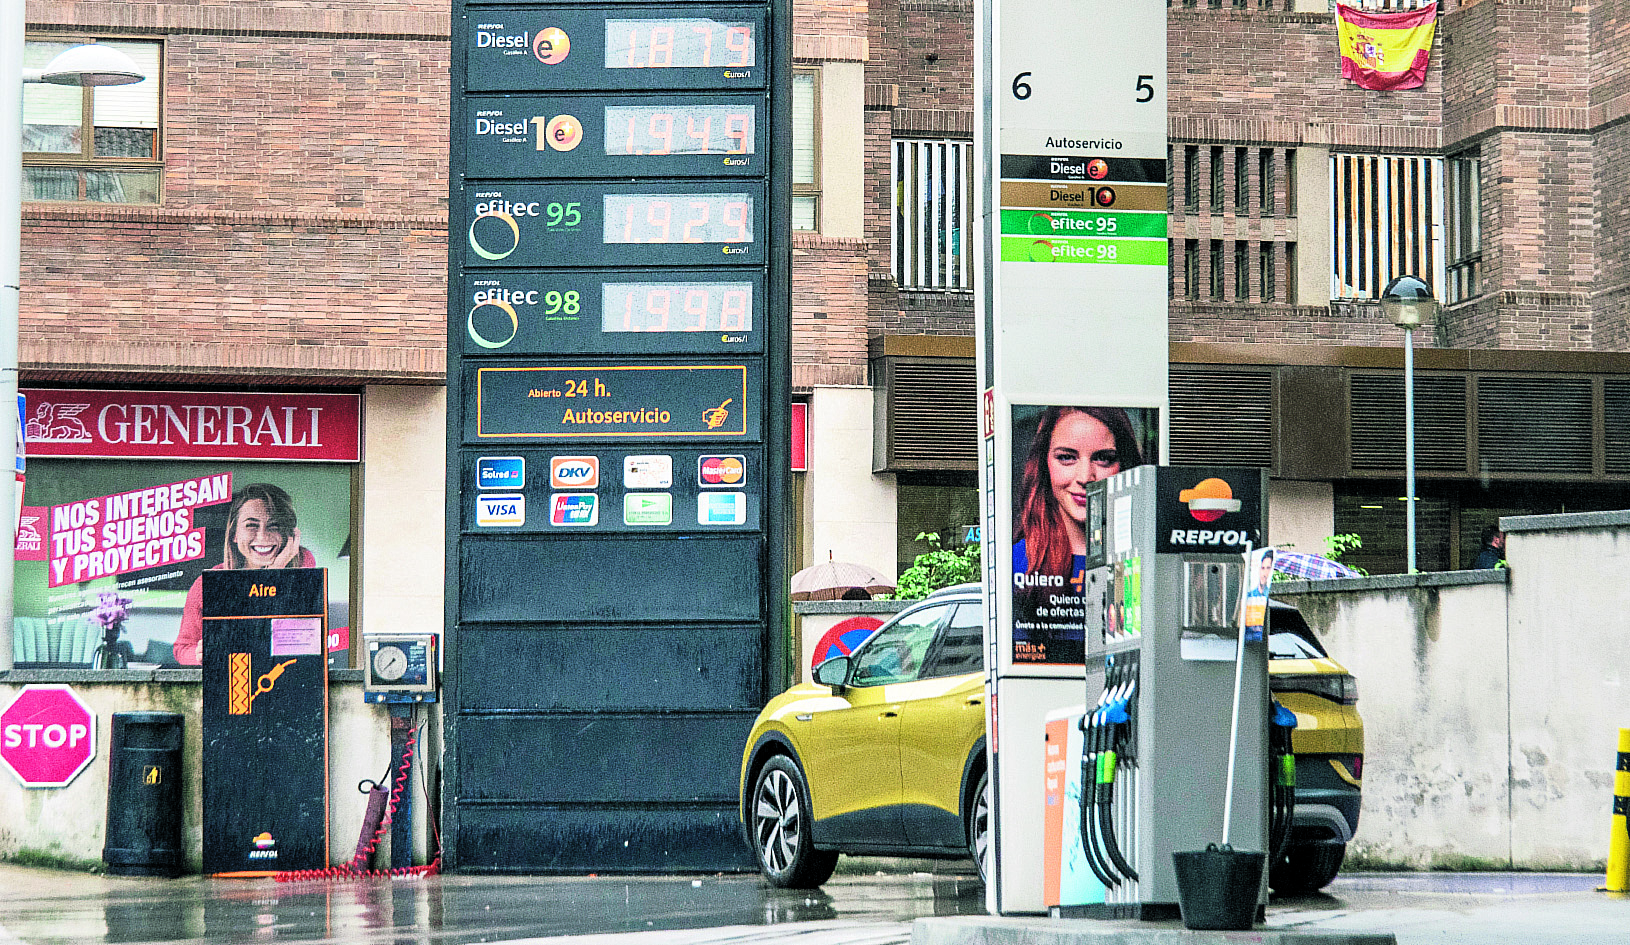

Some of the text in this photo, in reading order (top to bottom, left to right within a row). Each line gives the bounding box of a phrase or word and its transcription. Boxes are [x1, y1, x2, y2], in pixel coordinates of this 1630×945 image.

[476, 31, 529, 48] Diesel
[1012, 71, 1032, 101] 6
[1135, 75, 1155, 103] 5
[475, 118, 528, 135] Diesel
[1045, 136, 1123, 150] Autoservicio
[1050, 162, 1085, 174] Diesel
[1050, 190, 1084, 202] Diesel
[475, 199, 582, 227] efitec 95
[1050, 217, 1117, 231] efitec 95
[1051, 244, 1117, 259] efitec 98
[473, 288, 581, 315] efitec 98
[528, 378, 611, 398] Abierto 24 h.
[562, 407, 671, 424] Autoservicio
[97, 403, 324, 447] GENERALI
[482, 470, 509, 479] Solred
[558, 467, 591, 478] DKV
[702, 467, 742, 475] MasterCard
[53, 474, 228, 532] NOS INTERESAN
[487, 504, 517, 516] VISA
[557, 501, 592, 511] UnionPay
[52, 507, 189, 558] TUS SUEÑOS
[1170, 529, 1249, 546] REPSOL
[52, 531, 202, 584] Y PROYECTOS
[137, 570, 184, 586] asesoramiento
[1013, 570, 1064, 589] Quiero
[248, 583, 277, 597] Aire
[1049, 594, 1080, 606] Quiero
[1036, 606, 1085, 617] de ofertas
[1041, 622, 1048, 630] la
[1049, 622, 1083, 630] comunidad
[5, 724, 87, 748] STOP
